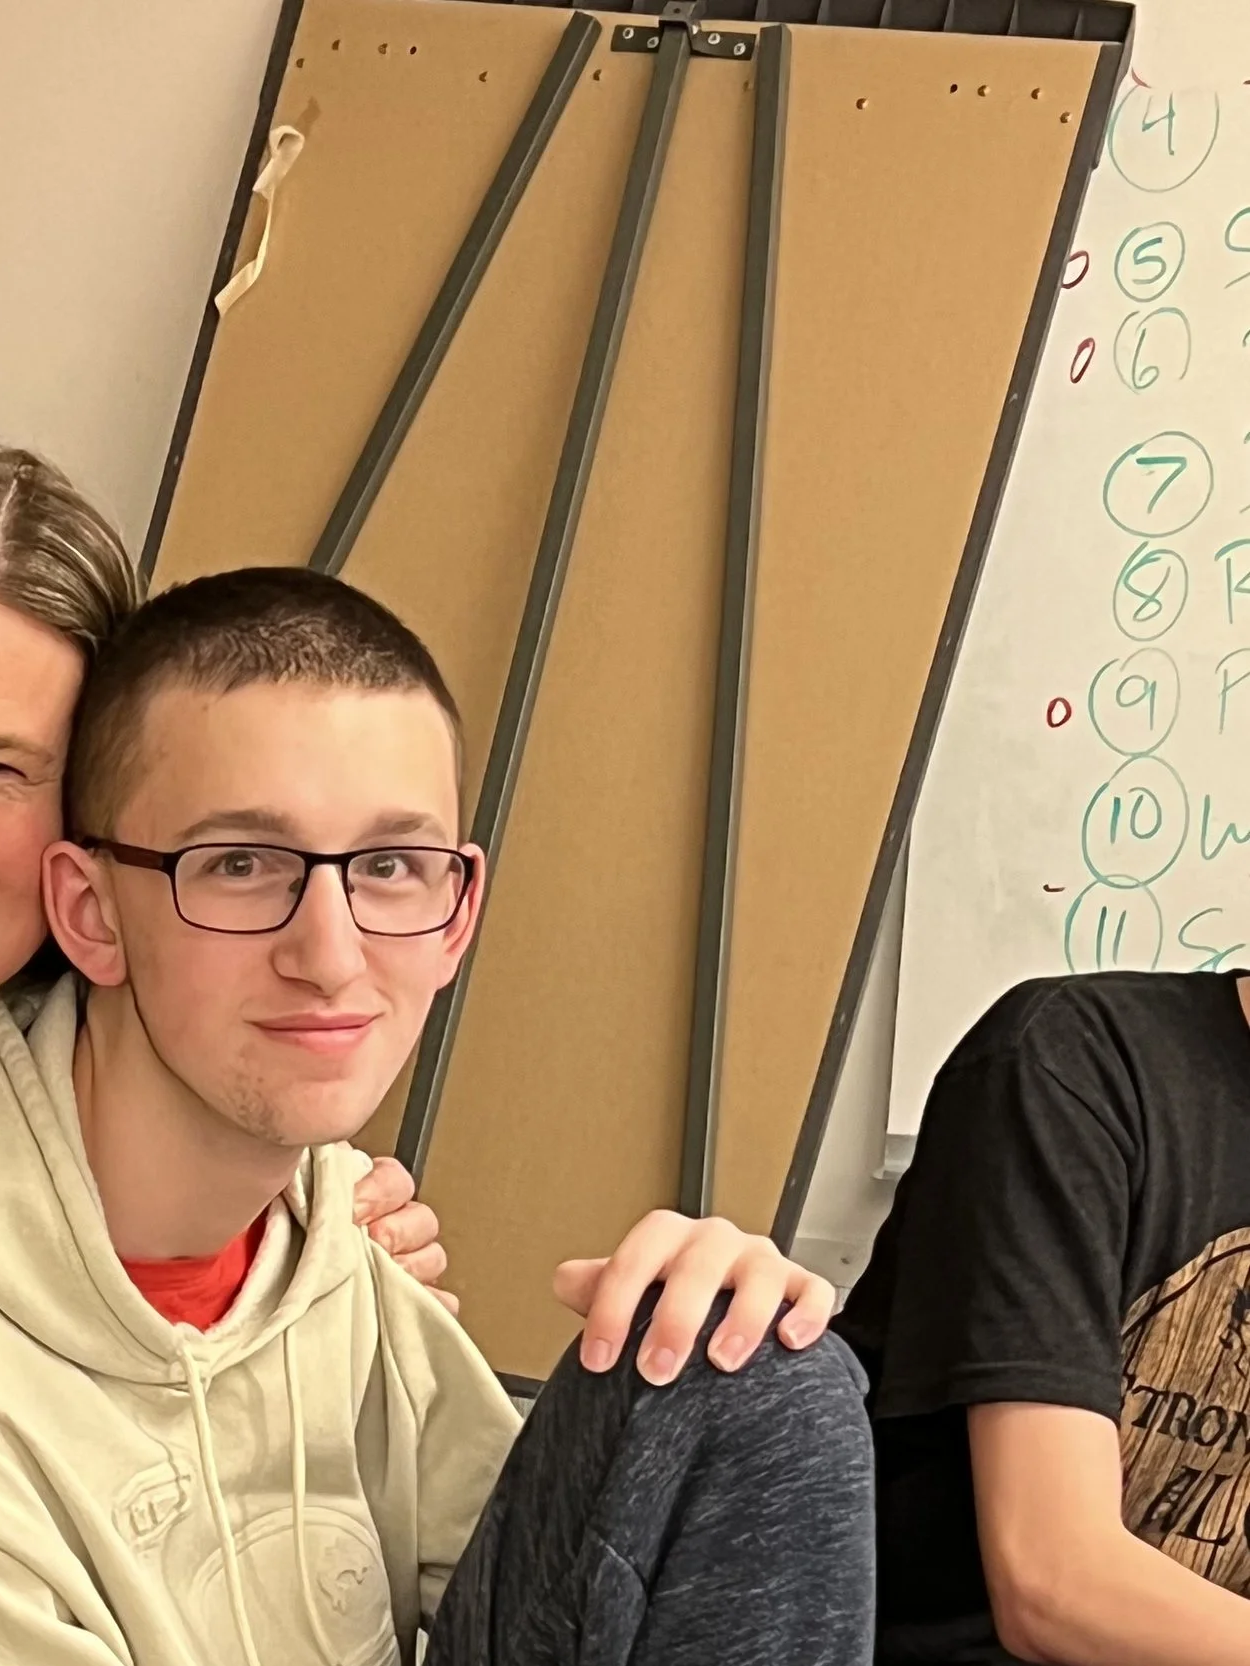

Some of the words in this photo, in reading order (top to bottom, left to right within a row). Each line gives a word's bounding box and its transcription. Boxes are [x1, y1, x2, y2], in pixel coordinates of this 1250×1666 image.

[1141, 92, 1176, 156] 4
[1132, 236, 1167, 286] 5
[1131, 327, 1161, 391] 6
[1134, 455, 1188, 515] 7
[1122, 552, 1171, 622] 8
[1115, 674, 1158, 732] 9
[1109, 787, 1163, 846] 10
[1095, 904, 1128, 971] 11
